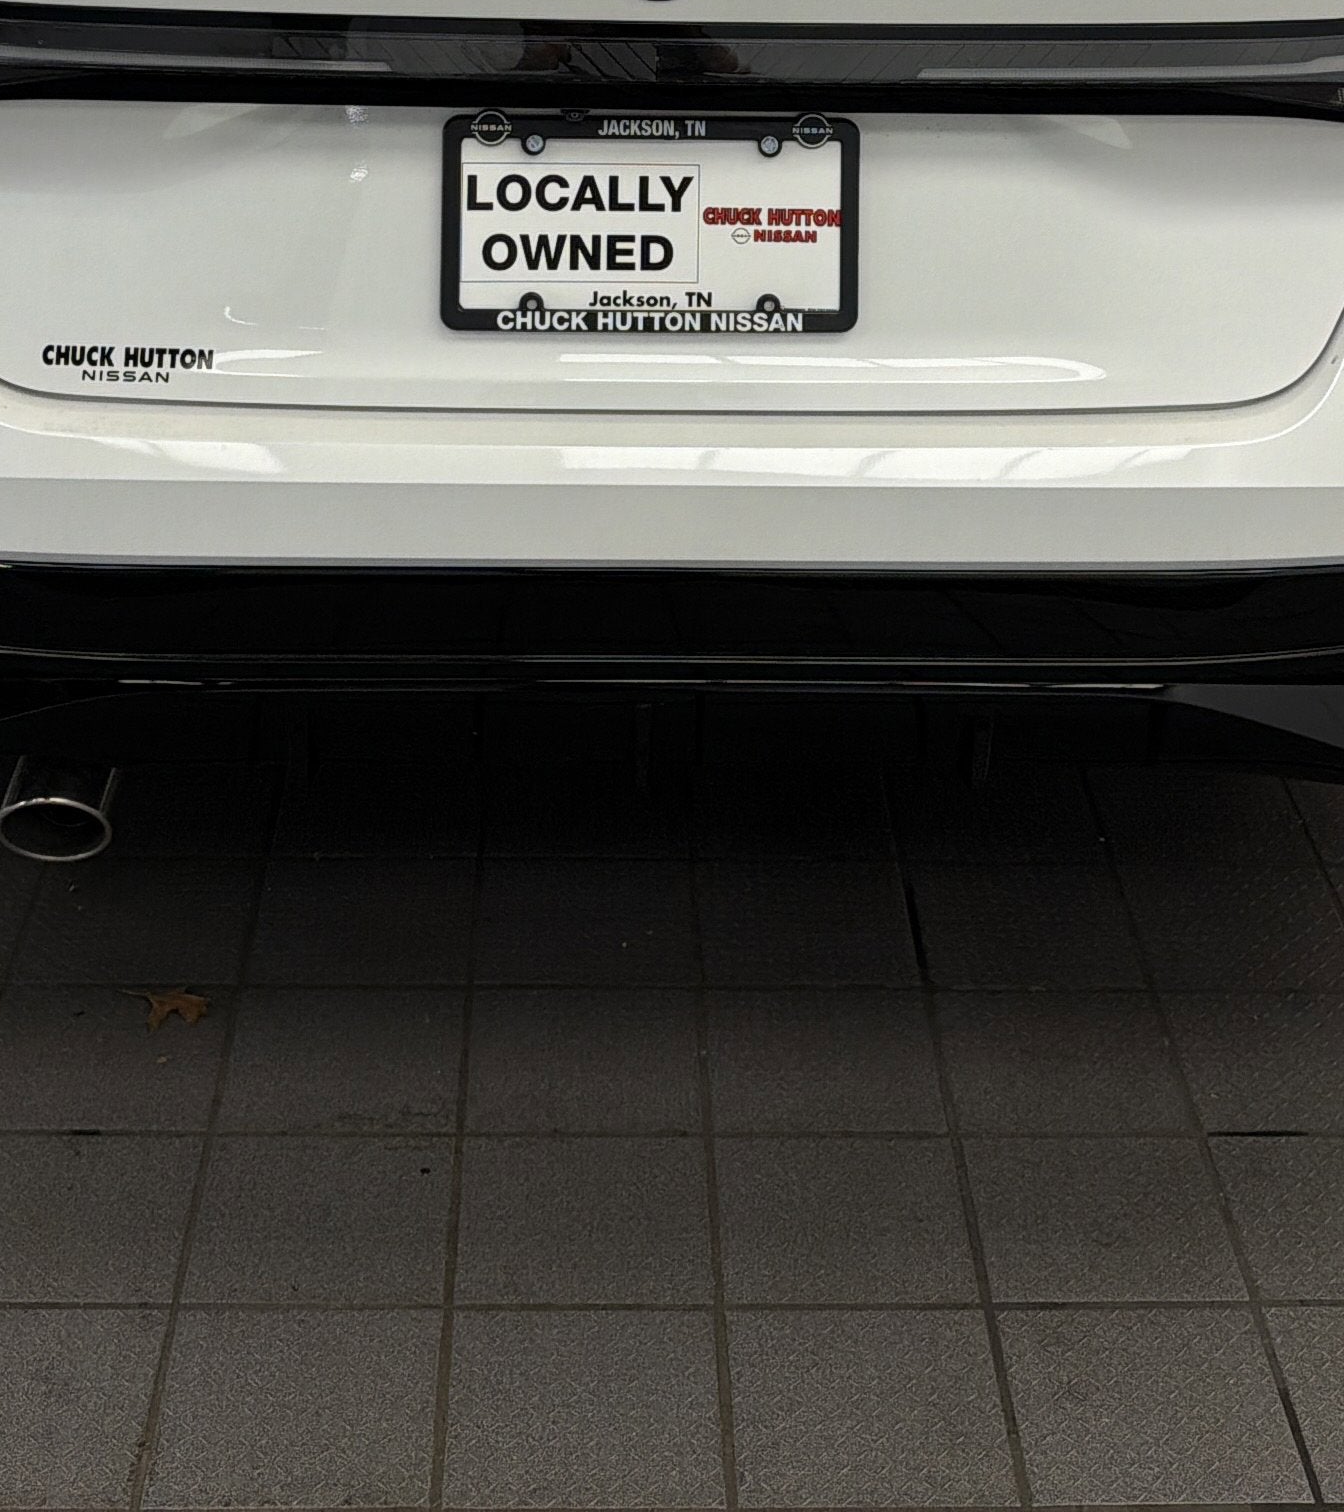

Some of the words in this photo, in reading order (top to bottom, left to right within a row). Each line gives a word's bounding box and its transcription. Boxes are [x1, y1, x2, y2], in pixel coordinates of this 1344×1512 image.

[470, 123, 513, 133] NISSAN
[597, 119, 680, 140] JACKSON,
[683, 120, 706, 138] TN
[792, 126, 834, 136] NISSAN
[466, 174, 694, 213] LOCALLY
[703, 207, 762, 226] CHUCK
[767, 208, 842, 227] HUTTON
[753, 229, 817, 243] NISSAN
[481, 233, 674, 272] OWNED
[588, 291, 677, 310] Jackson,
[685, 292, 713, 308] TN
[496, 310, 588, 331] CHUCK
[597, 311, 705, 332] HUTTON
[710, 312, 803, 332] NISSAN
[42, 344, 115, 367] CHUCK
[123, 347, 214, 370] HUTTON
[81, 369, 169, 383] NISSAN
